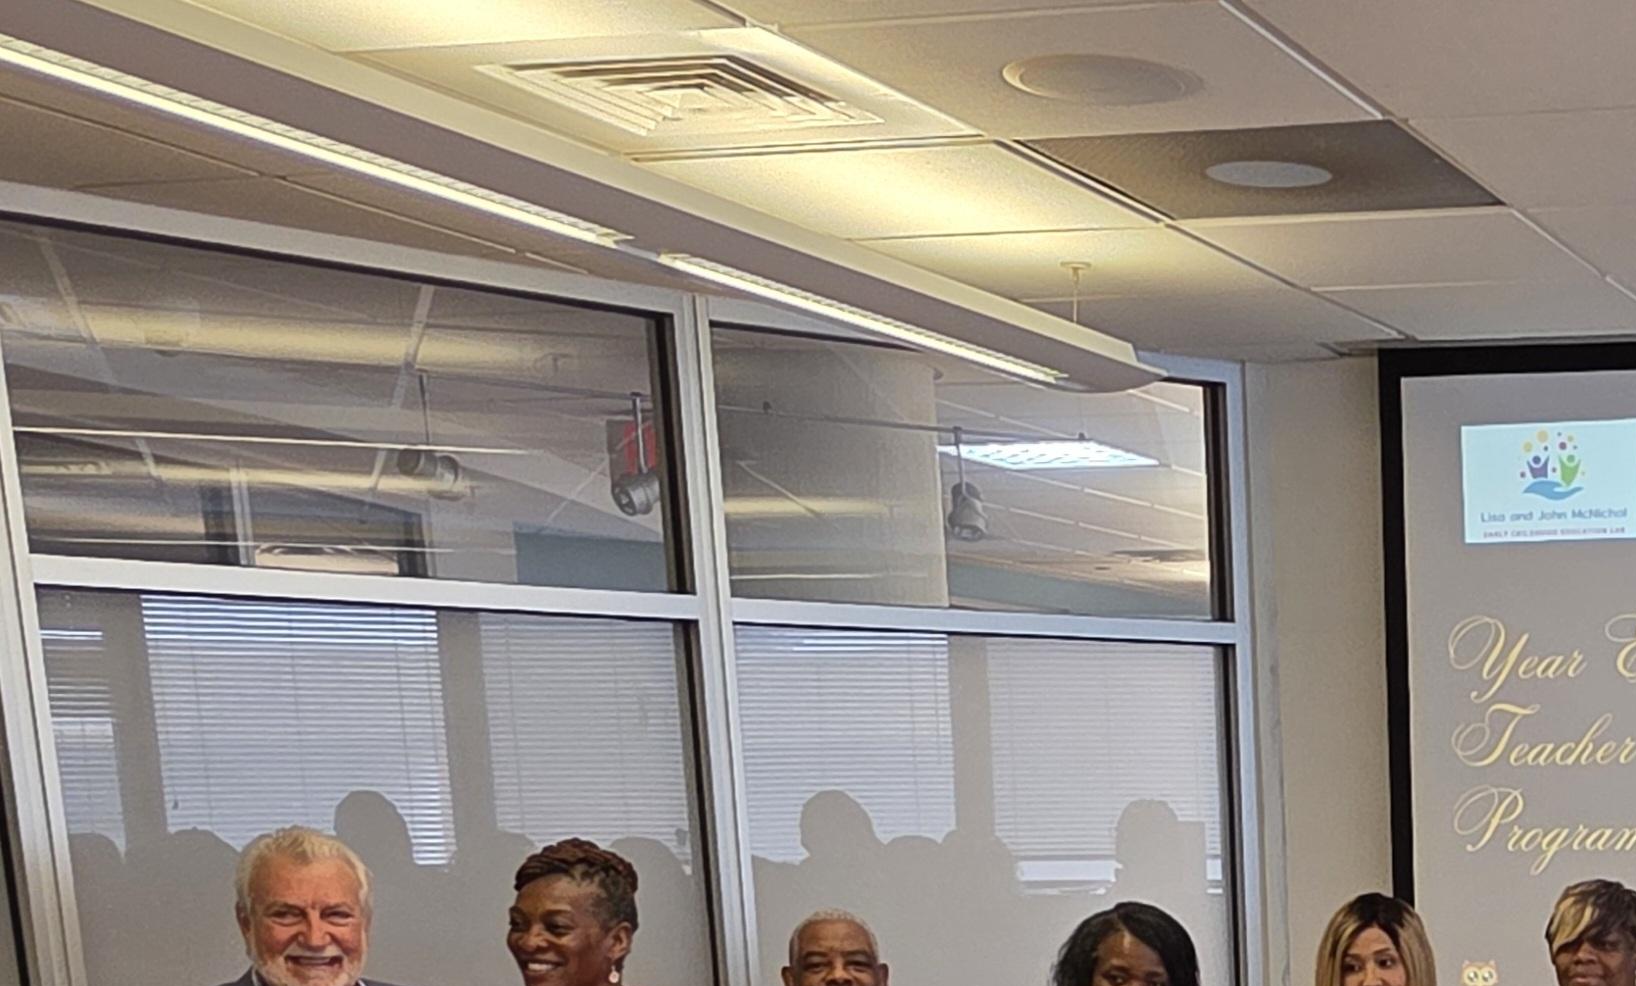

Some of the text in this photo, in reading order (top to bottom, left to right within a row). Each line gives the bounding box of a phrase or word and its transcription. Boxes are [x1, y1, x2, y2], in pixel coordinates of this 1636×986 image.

[1480, 507, 1627, 523] Lisa and John McNichol
[1448, 614, 1587, 703] Year
